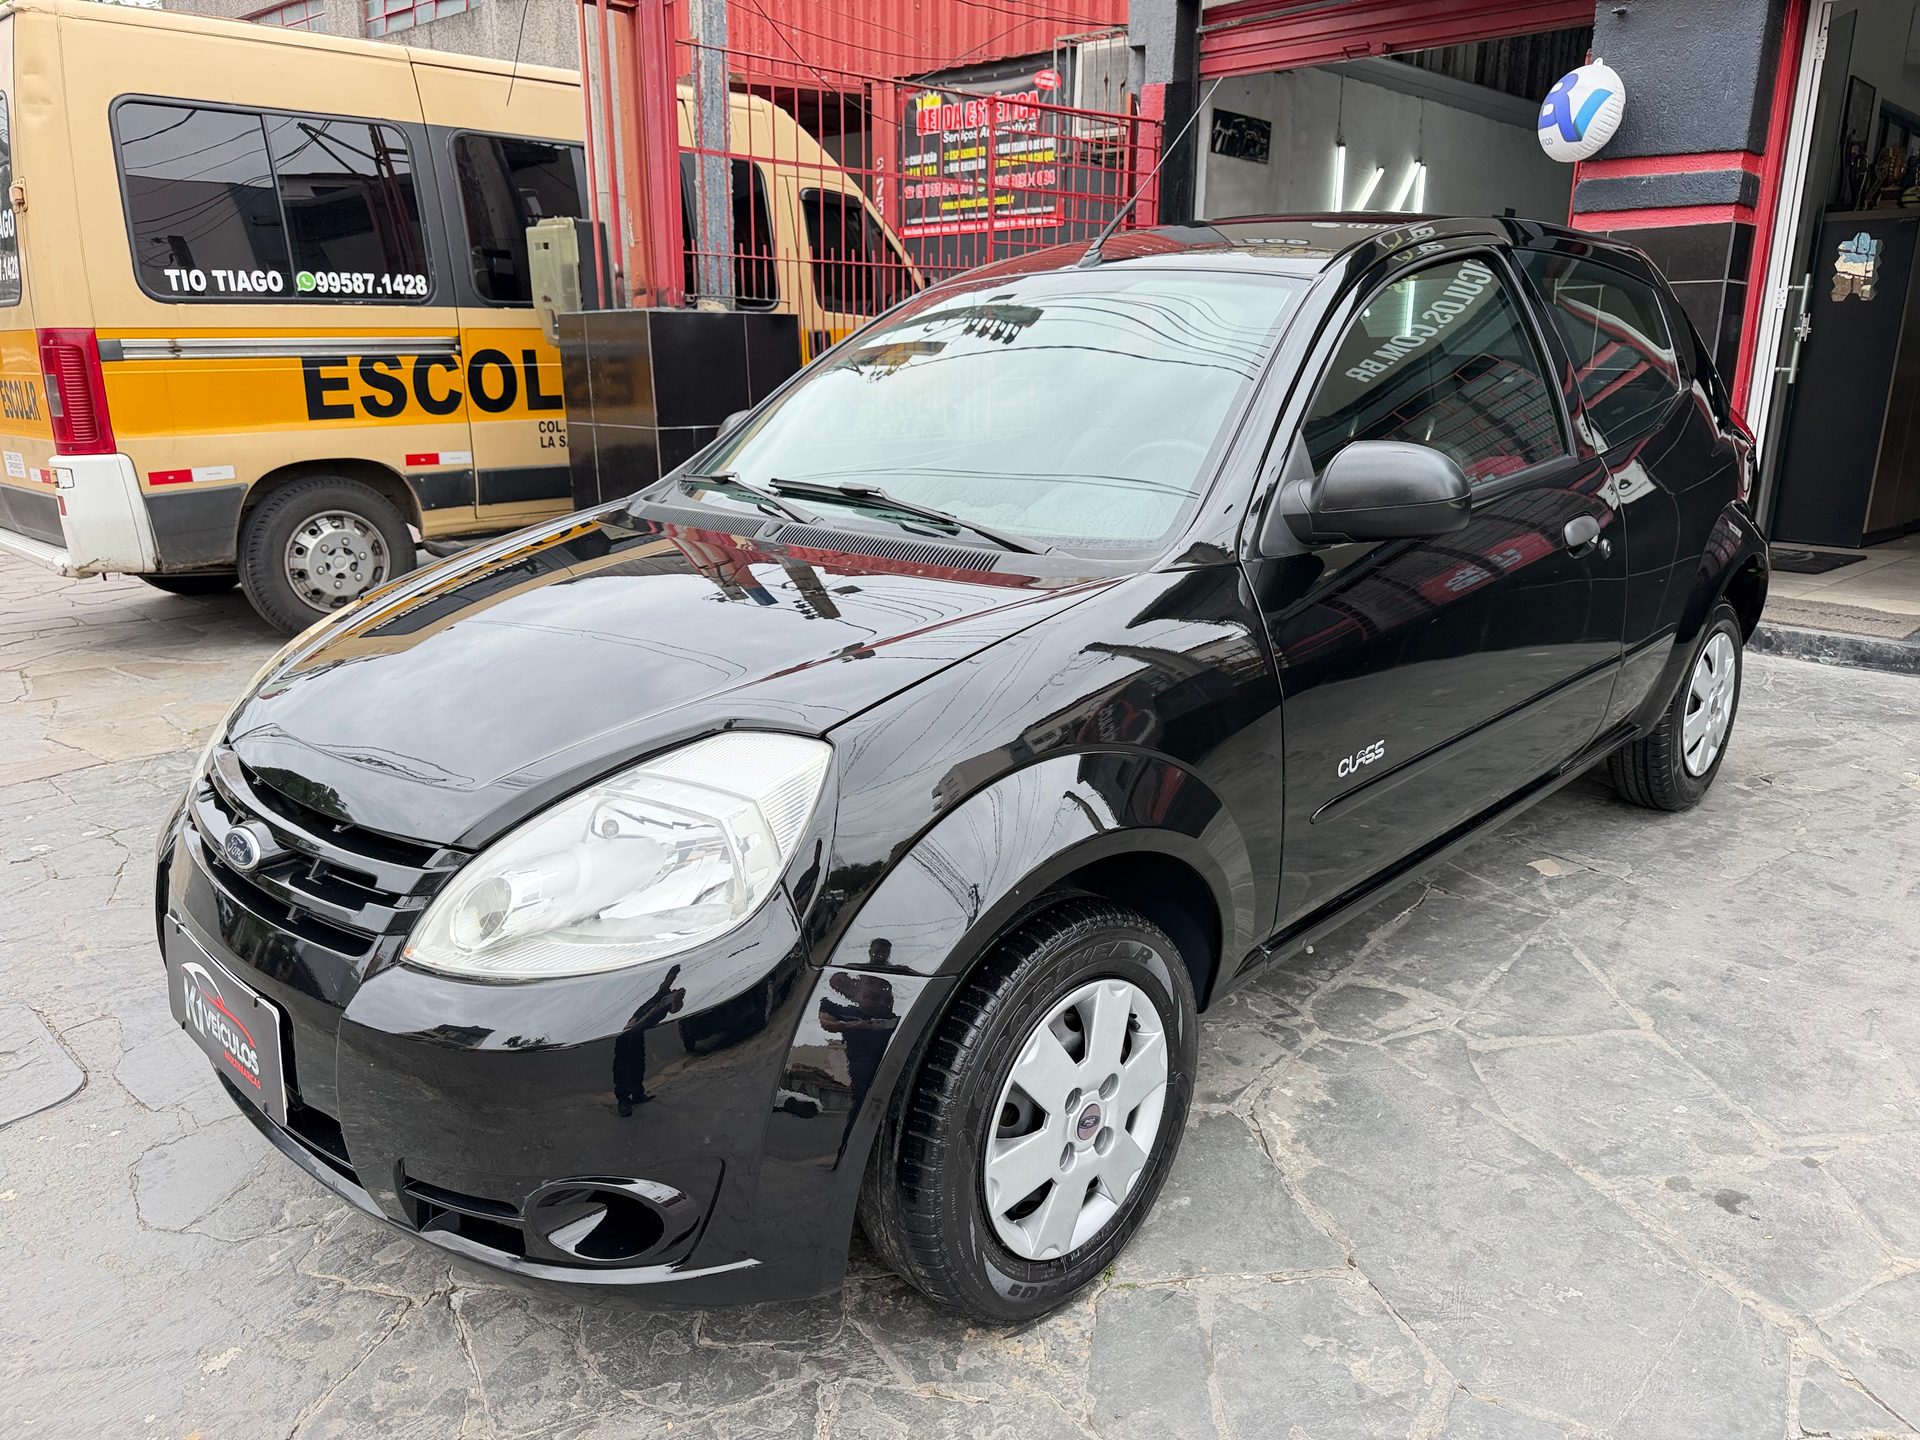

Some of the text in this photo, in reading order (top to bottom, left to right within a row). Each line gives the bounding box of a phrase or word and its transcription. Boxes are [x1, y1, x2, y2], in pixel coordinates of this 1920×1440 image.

[943, 103, 964, 130] DA
[0, 256, 19, 281] .1428
[164, 269, 428, 296] TIO TIAGO 99587.1428
[302, 348, 564, 421] ESCOL
[0, 379, 41, 421] ESCOLAR
[538, 420, 566, 434] COL.
[540, 435, 569, 449] LA S
[1337, 739, 1385, 778] CLASS
[227, 834, 247, 862] Ford
[183, 975, 261, 1076] K1 VEÍCULOS
